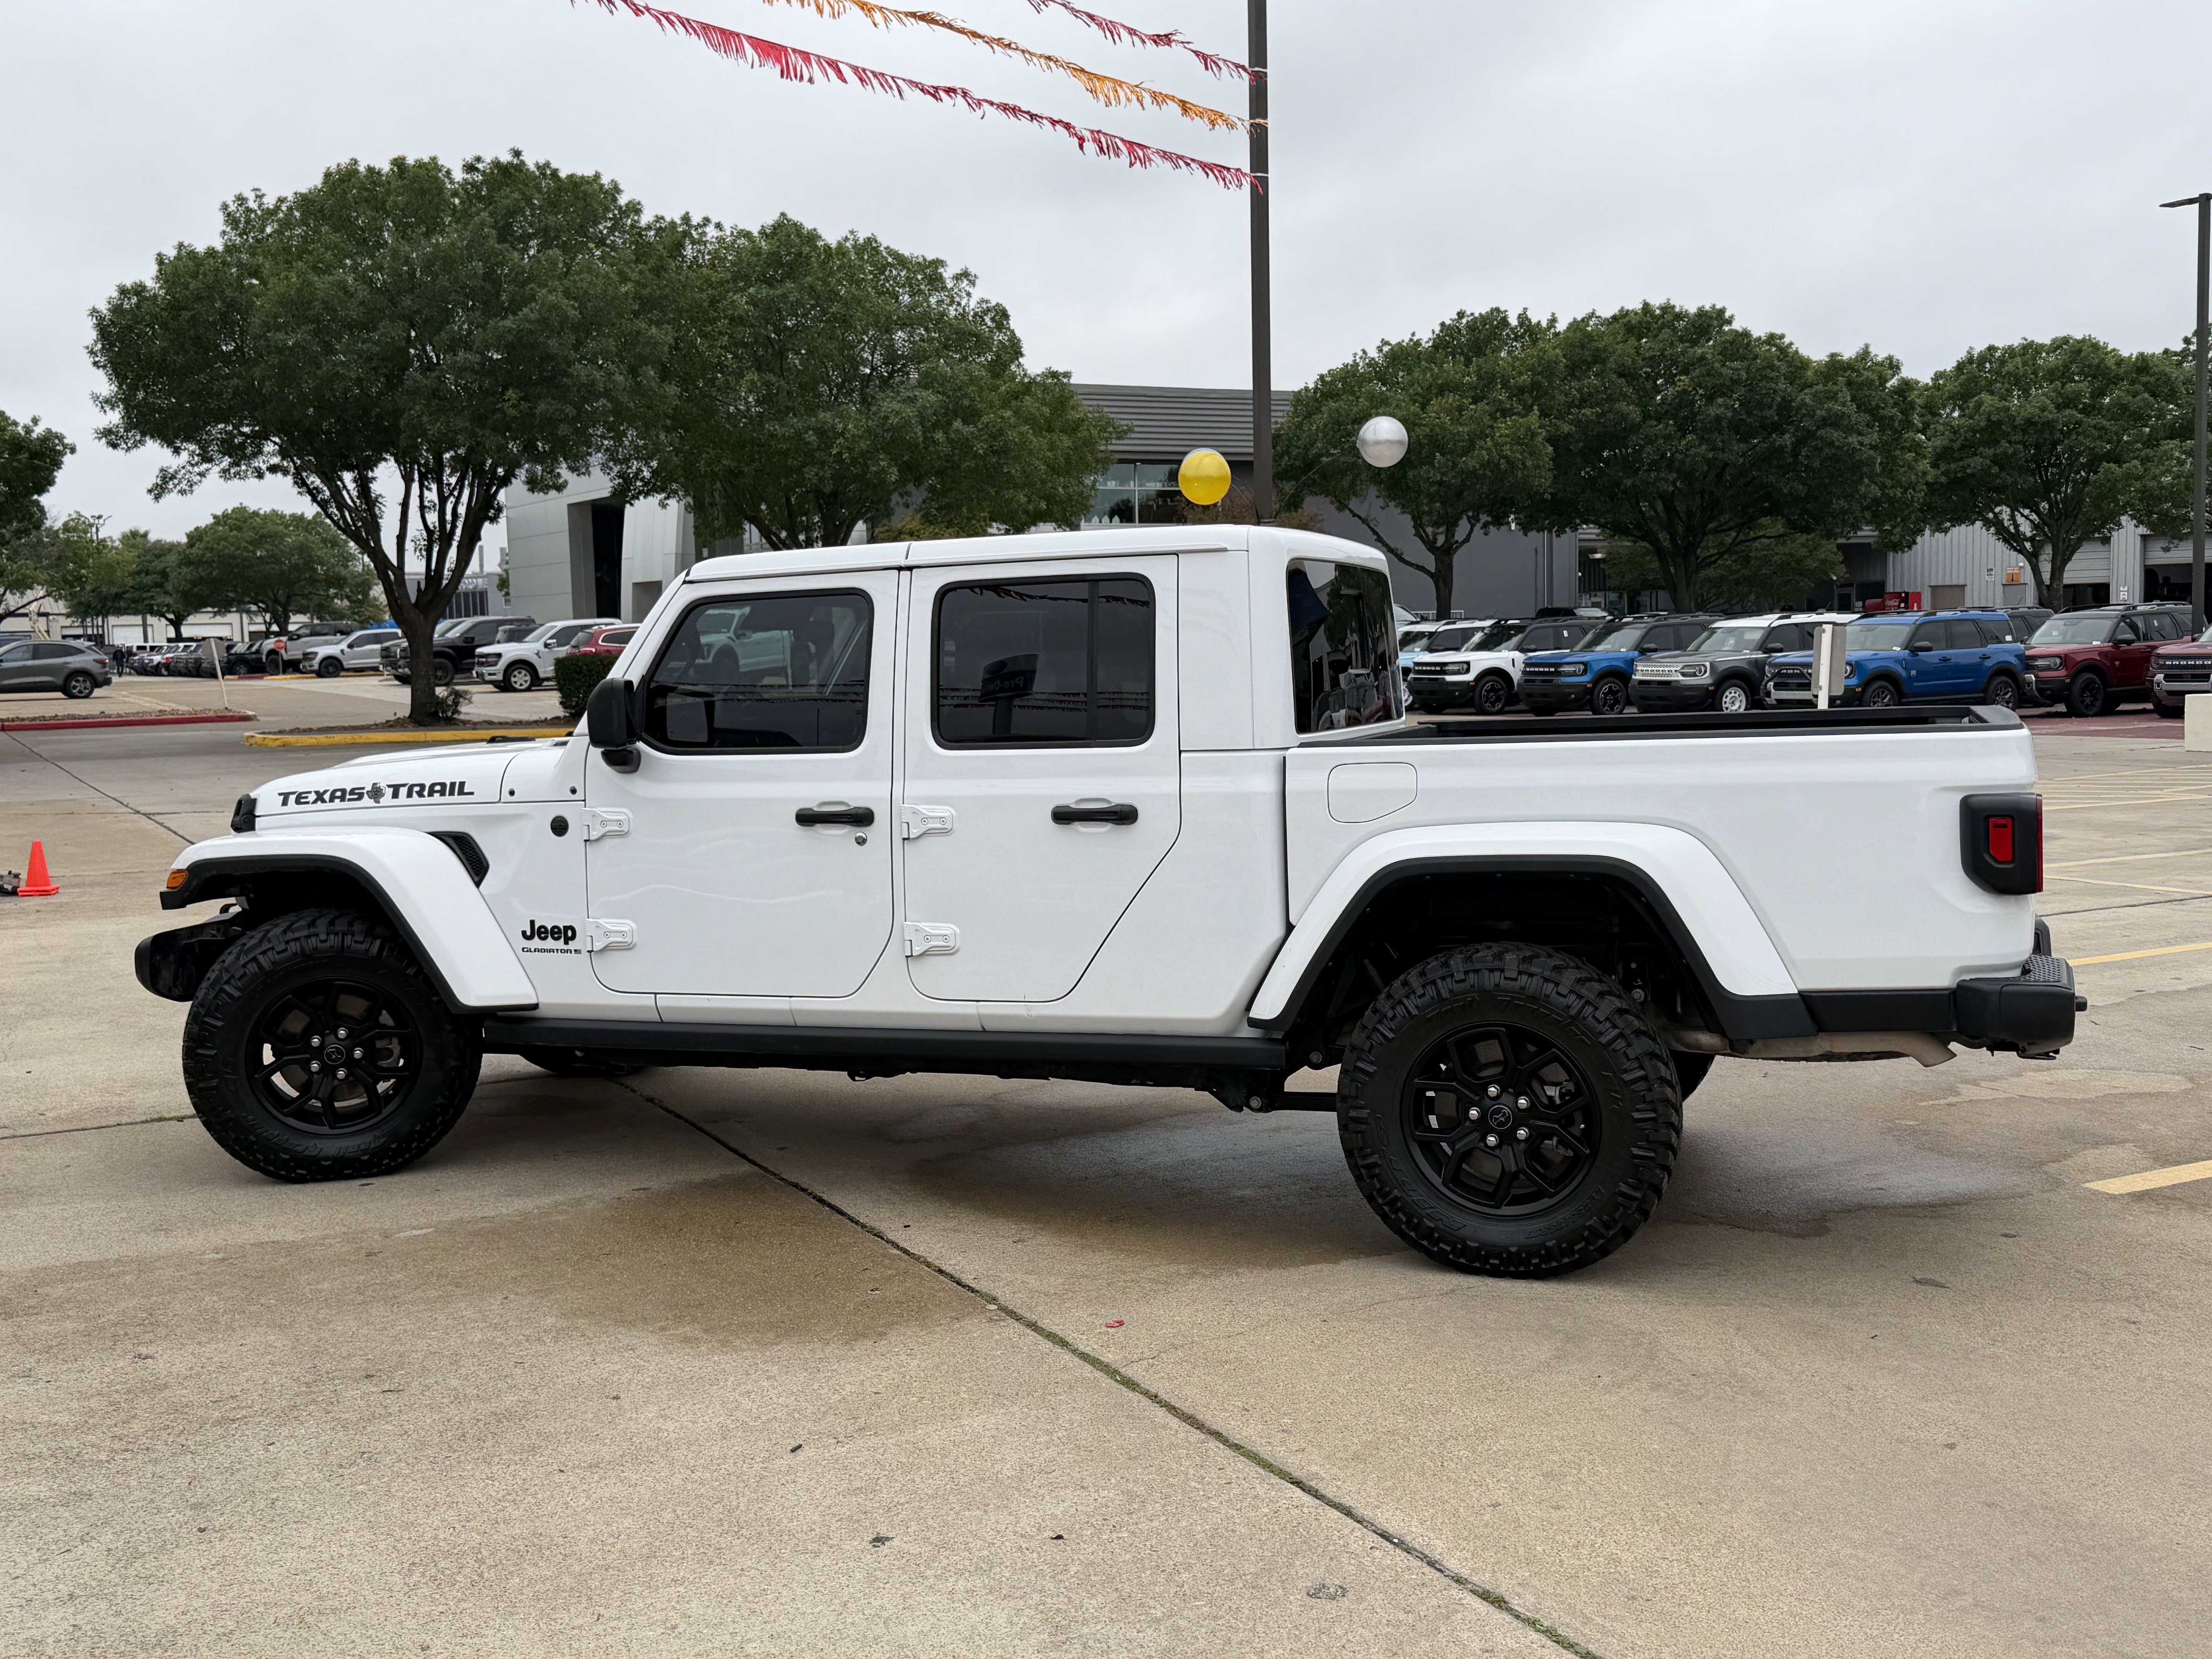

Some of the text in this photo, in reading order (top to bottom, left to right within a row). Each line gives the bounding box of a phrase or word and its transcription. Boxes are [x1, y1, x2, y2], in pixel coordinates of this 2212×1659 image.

[277, 781, 475, 807] TEXAS TRAIL
[521, 919, 577, 945] Jeep
